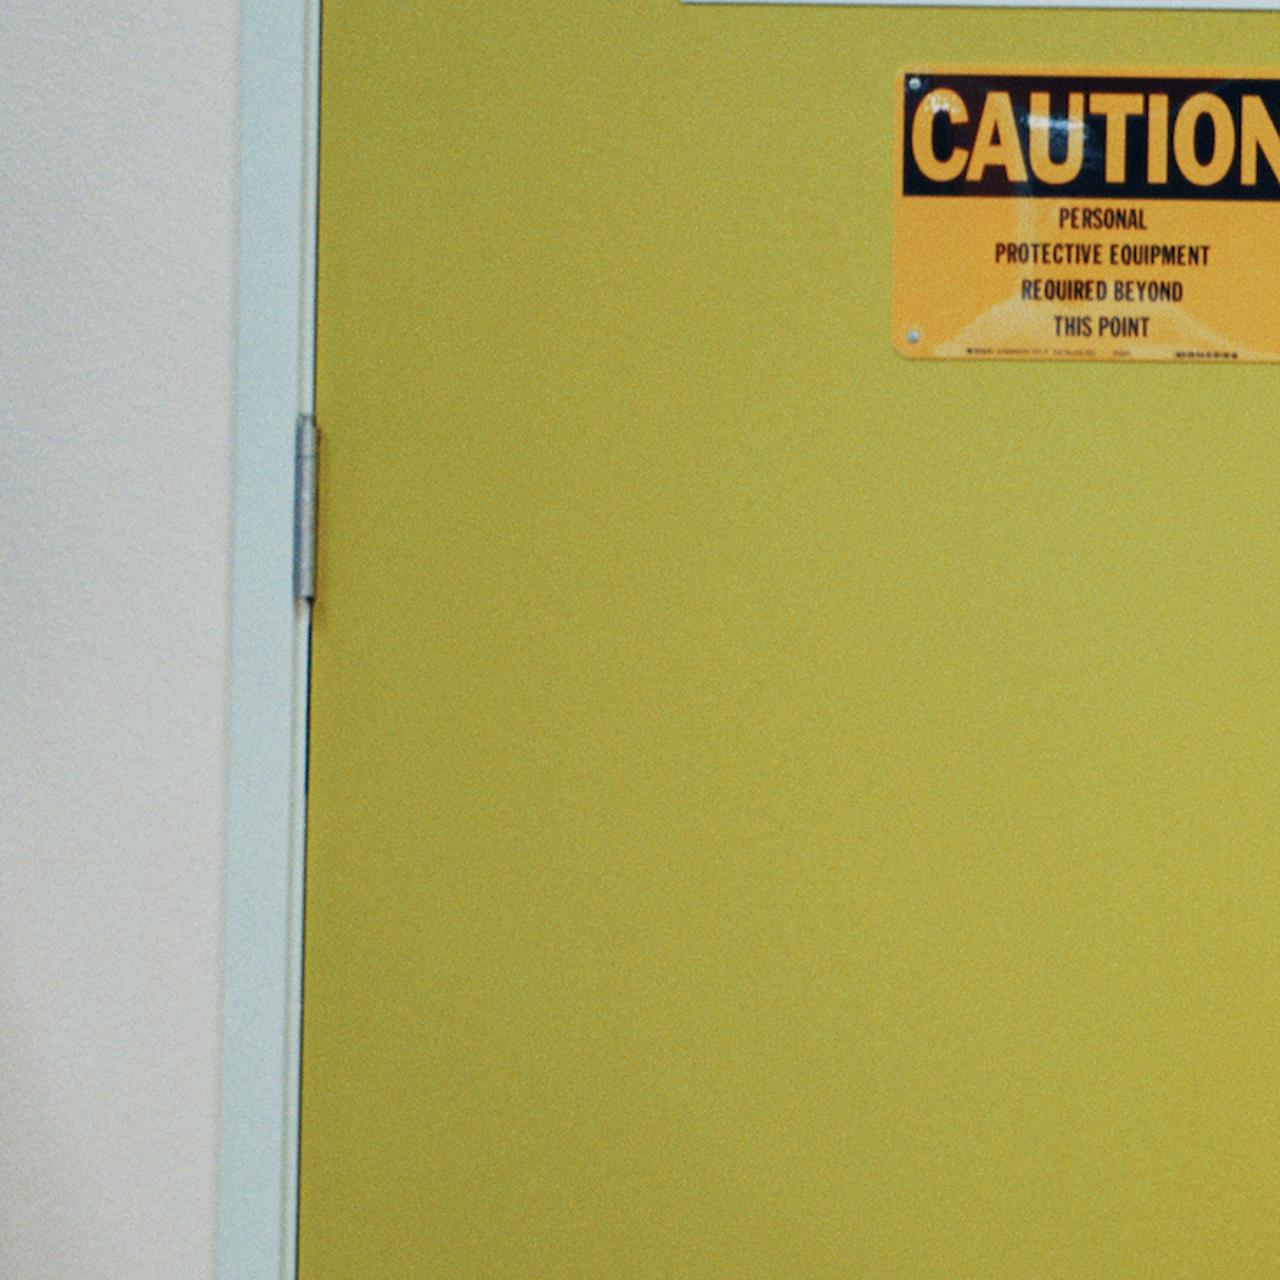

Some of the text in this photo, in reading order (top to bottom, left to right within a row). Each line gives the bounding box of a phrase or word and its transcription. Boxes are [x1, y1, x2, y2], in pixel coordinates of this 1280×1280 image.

[1058, 207, 1147, 231] PERSONAL
[994, 243, 1210, 266] PROTECTIVE EQUIPMENT
[1021, 279, 1183, 302] REQUIRED BEYOND
[1053, 316, 1150, 338] THIS POINT
